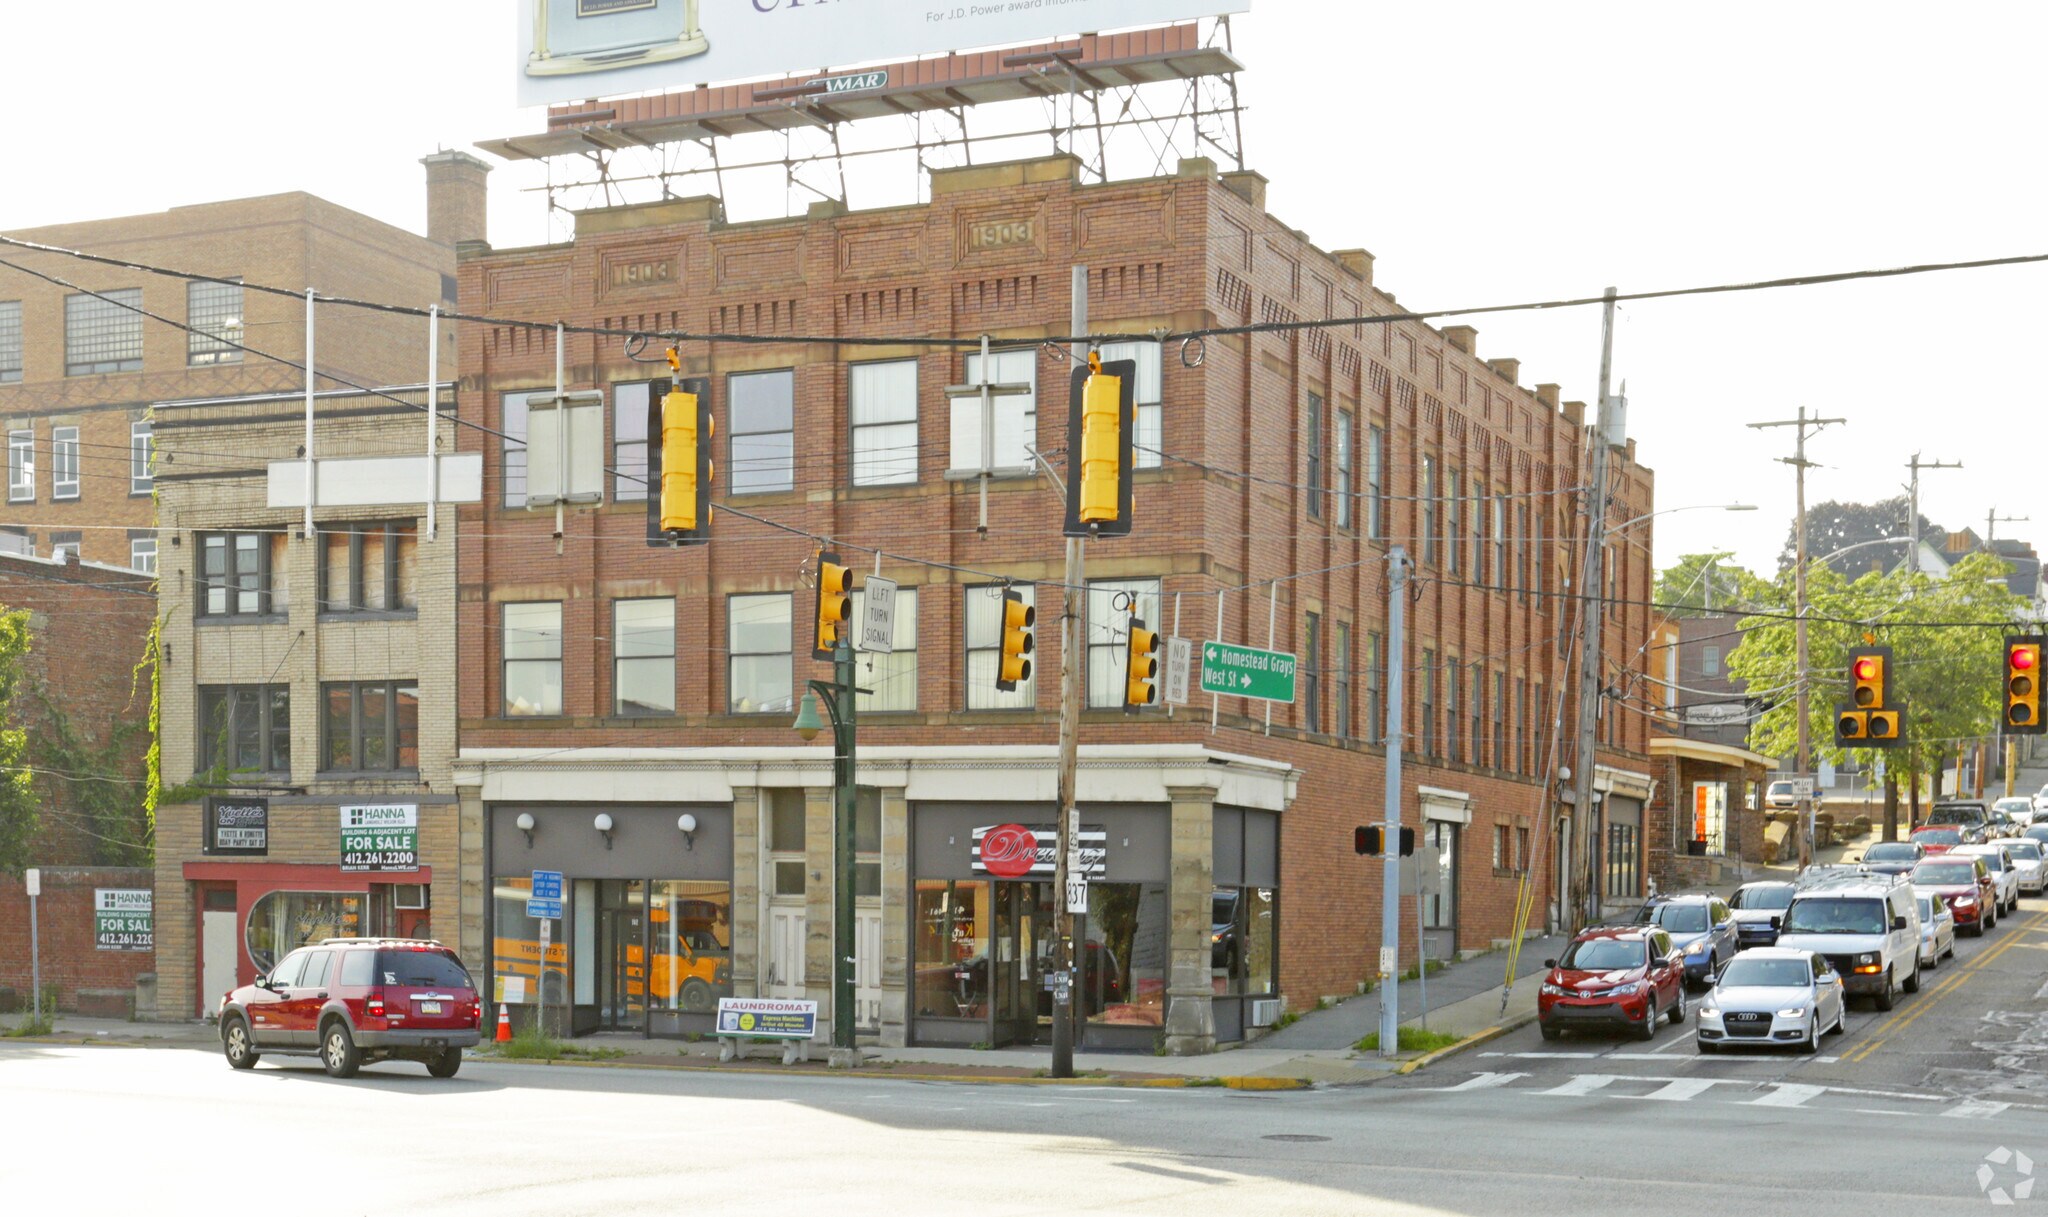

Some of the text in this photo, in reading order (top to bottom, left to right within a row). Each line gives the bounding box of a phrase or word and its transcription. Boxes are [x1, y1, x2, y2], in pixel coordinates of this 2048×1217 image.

[926, 12, 944, 22] For
[947, 8, 967, 20] J.D.
[970, 3, 1004, 17] Power
[1008, 0, 1042, 11] award
[825, 74, 879, 92] AMAR
[972, 223, 1029, 247] 1903
[872, 587, 889, 603] LEFT
[870, 607, 888, 623] TURN
[866, 627, 890, 645] SIGNAL
[1173, 645, 1186, 659] NO
[1171, 660, 1186, 672] TURN
[1221, 648, 1294, 679] Homestead Grays
[1173, 674, 1182, 686] ON
[1204, 667, 1237, 688] West St
[1171, 687, 1183, 699] RED
[365, 808, 405, 819] HANNA
[374, 828, 403, 836] ADJACENT
[403, 827, 416, 835] LOT
[346, 836, 411, 850] FOR SALE
[344, 851, 414, 865] 412.261.2200
[981, 828, 1103, 874] Dreaz
[117, 893, 152, 903] HANNA
[1067, 882, 1087, 905] 837
[101, 918, 152, 932] FOR SAL
[724, 1002, 812, 1012] LAUNDROMAT
[762, 1014, 782, 1022] Express
[782, 1015, 805, 1023] Machines
